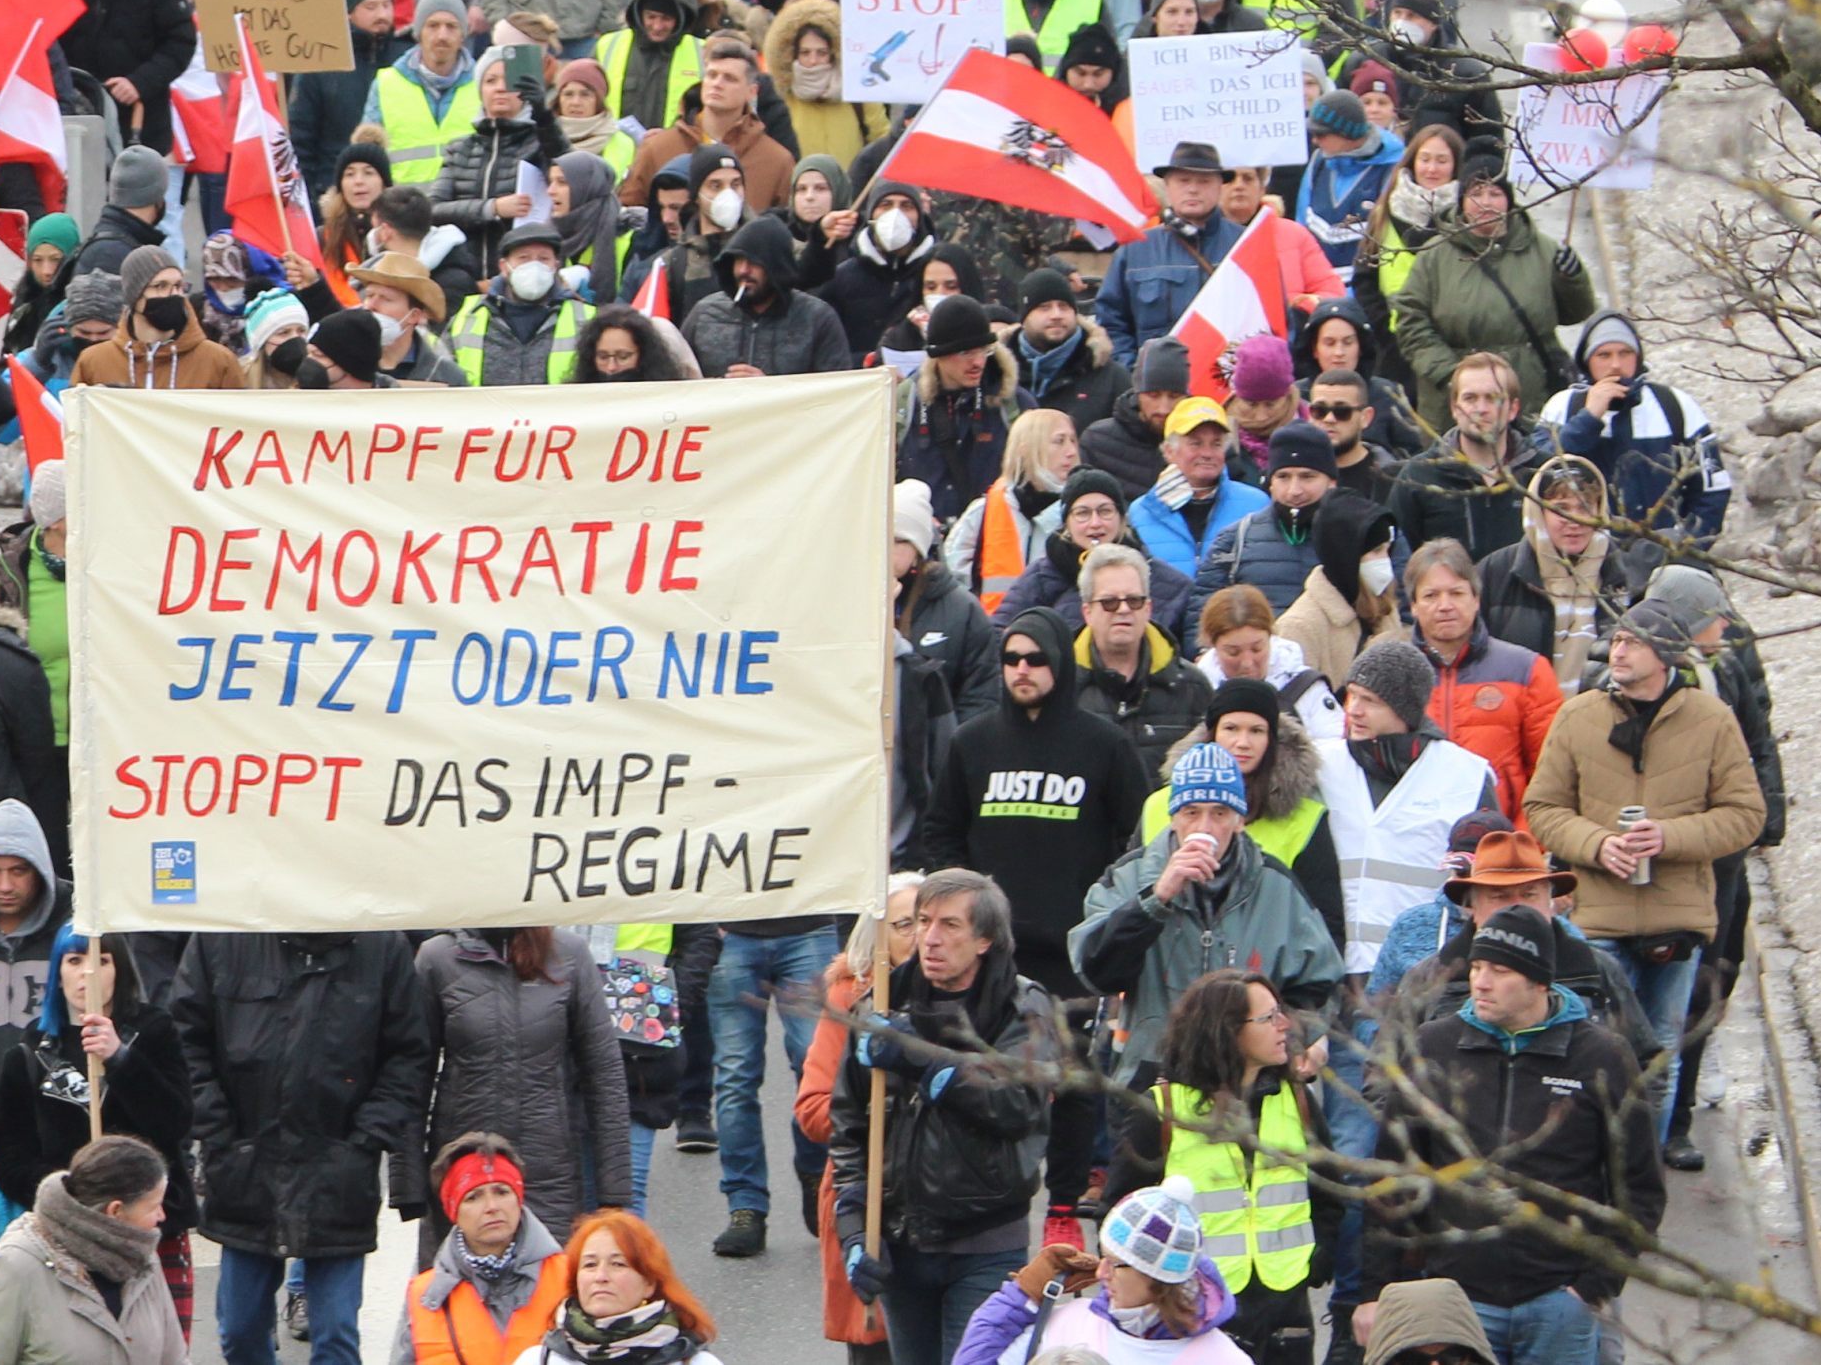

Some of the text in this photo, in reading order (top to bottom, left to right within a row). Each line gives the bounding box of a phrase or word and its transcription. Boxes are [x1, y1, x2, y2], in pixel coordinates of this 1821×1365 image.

[262, 7, 291, 32] DAS
[286, 32, 340, 62] GUT
[1153, 48, 1188, 66] ICH
[1209, 43, 1243, 62] BIN
[1136, 72, 1297, 97] SAUER DAS ICH
[1162, 98, 1281, 122] EIN SCHILD
[1243, 120, 1299, 140] HABE
[193, 420, 711, 491] KAMPF FÜR DIE
[158, 520, 705, 615] DEMOKRATIE
[168, 625, 779, 714] JETZT ODER NIE
[108, 753, 362, 821] STOPPT
[383, 756, 512, 828] DAS
[983, 770, 1086, 806] JUST DO
[990, 805, 1069, 819] NOTHING
[523, 827, 810, 903] REGIME
[1541, 1075, 1583, 1090] SCANIA
